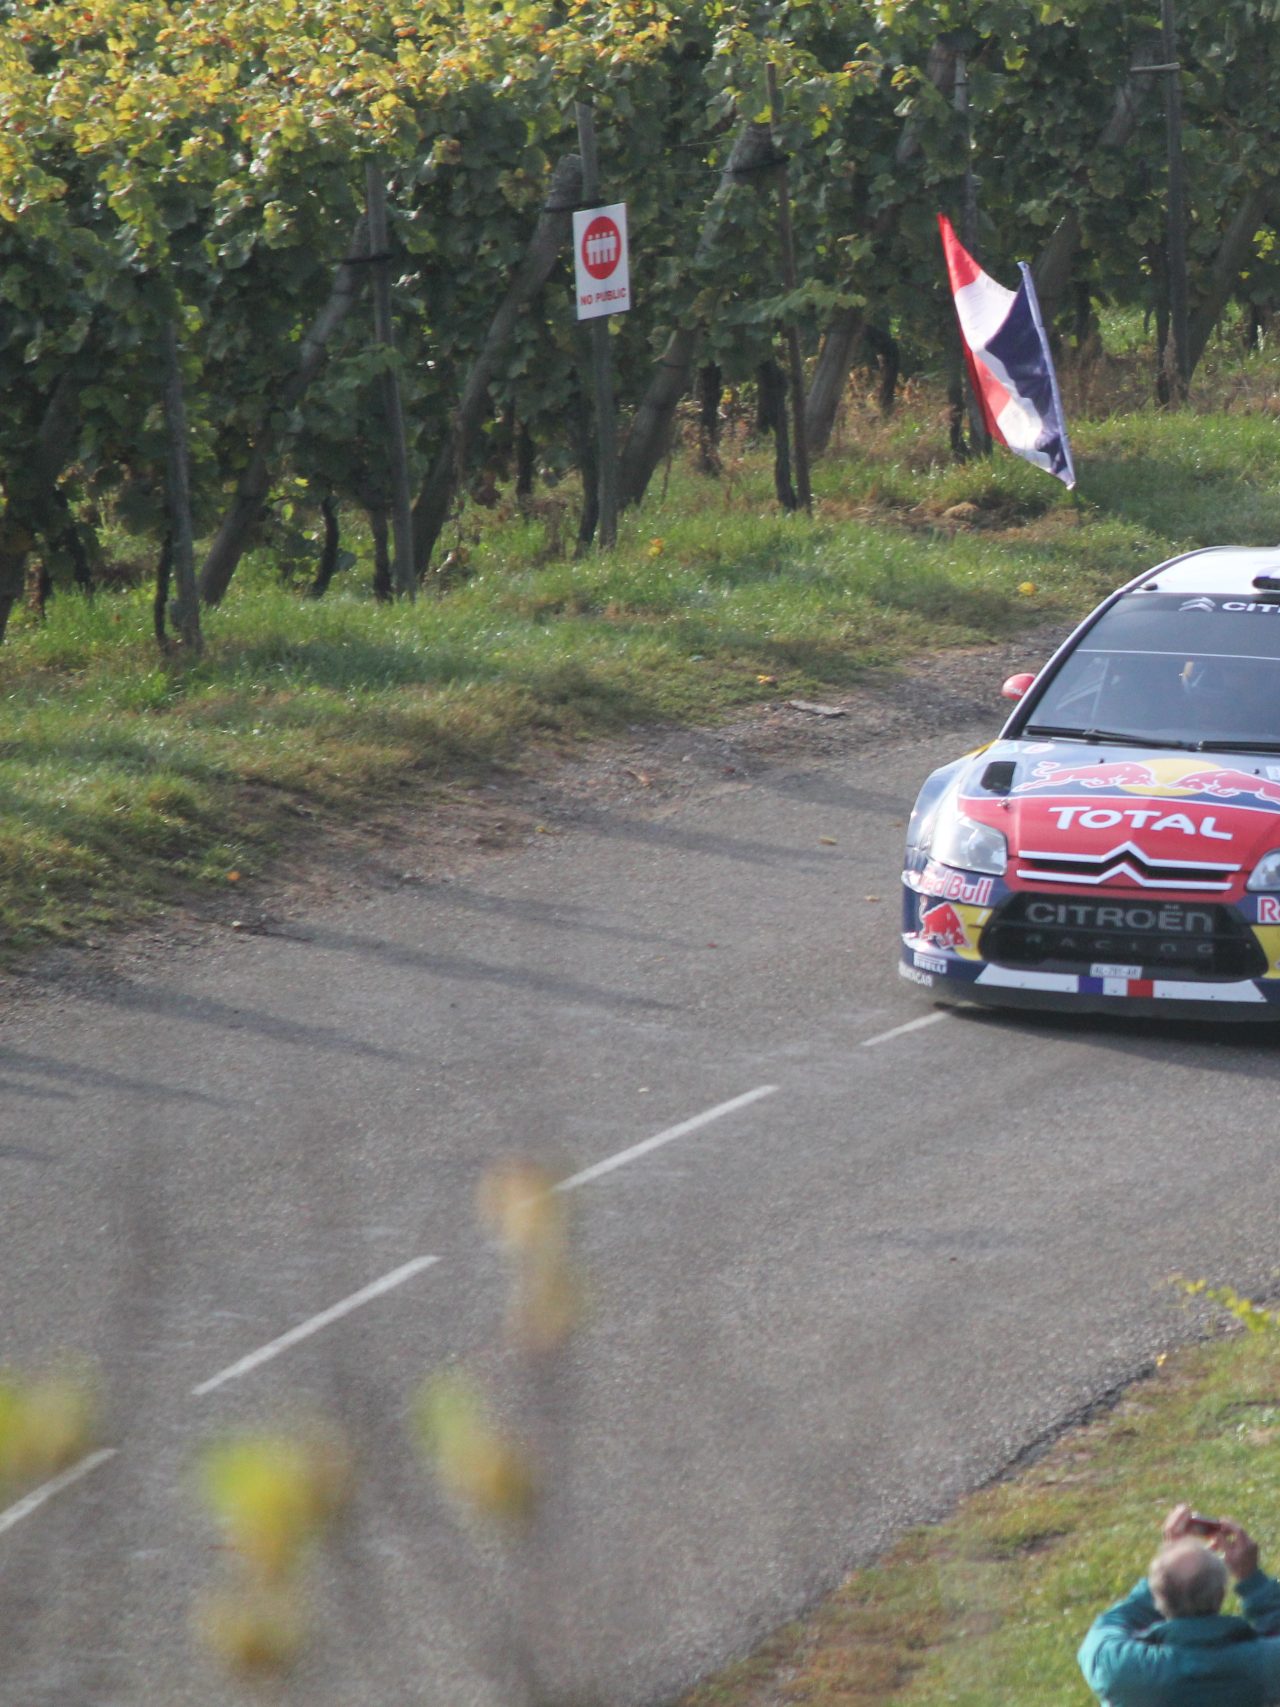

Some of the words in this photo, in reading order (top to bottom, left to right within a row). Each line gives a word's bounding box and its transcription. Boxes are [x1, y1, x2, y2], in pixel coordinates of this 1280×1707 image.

[580, 294, 593, 306] NO
[595, 288, 627, 303] PUBLIC
[1048, 806, 1234, 841] TOTAL
[947, 873, 994, 906] Bull
[1025, 902, 1214, 932] CITROËN
[1025, 934, 1215, 954] RACING
[913, 952, 948, 974] PIRELLI
